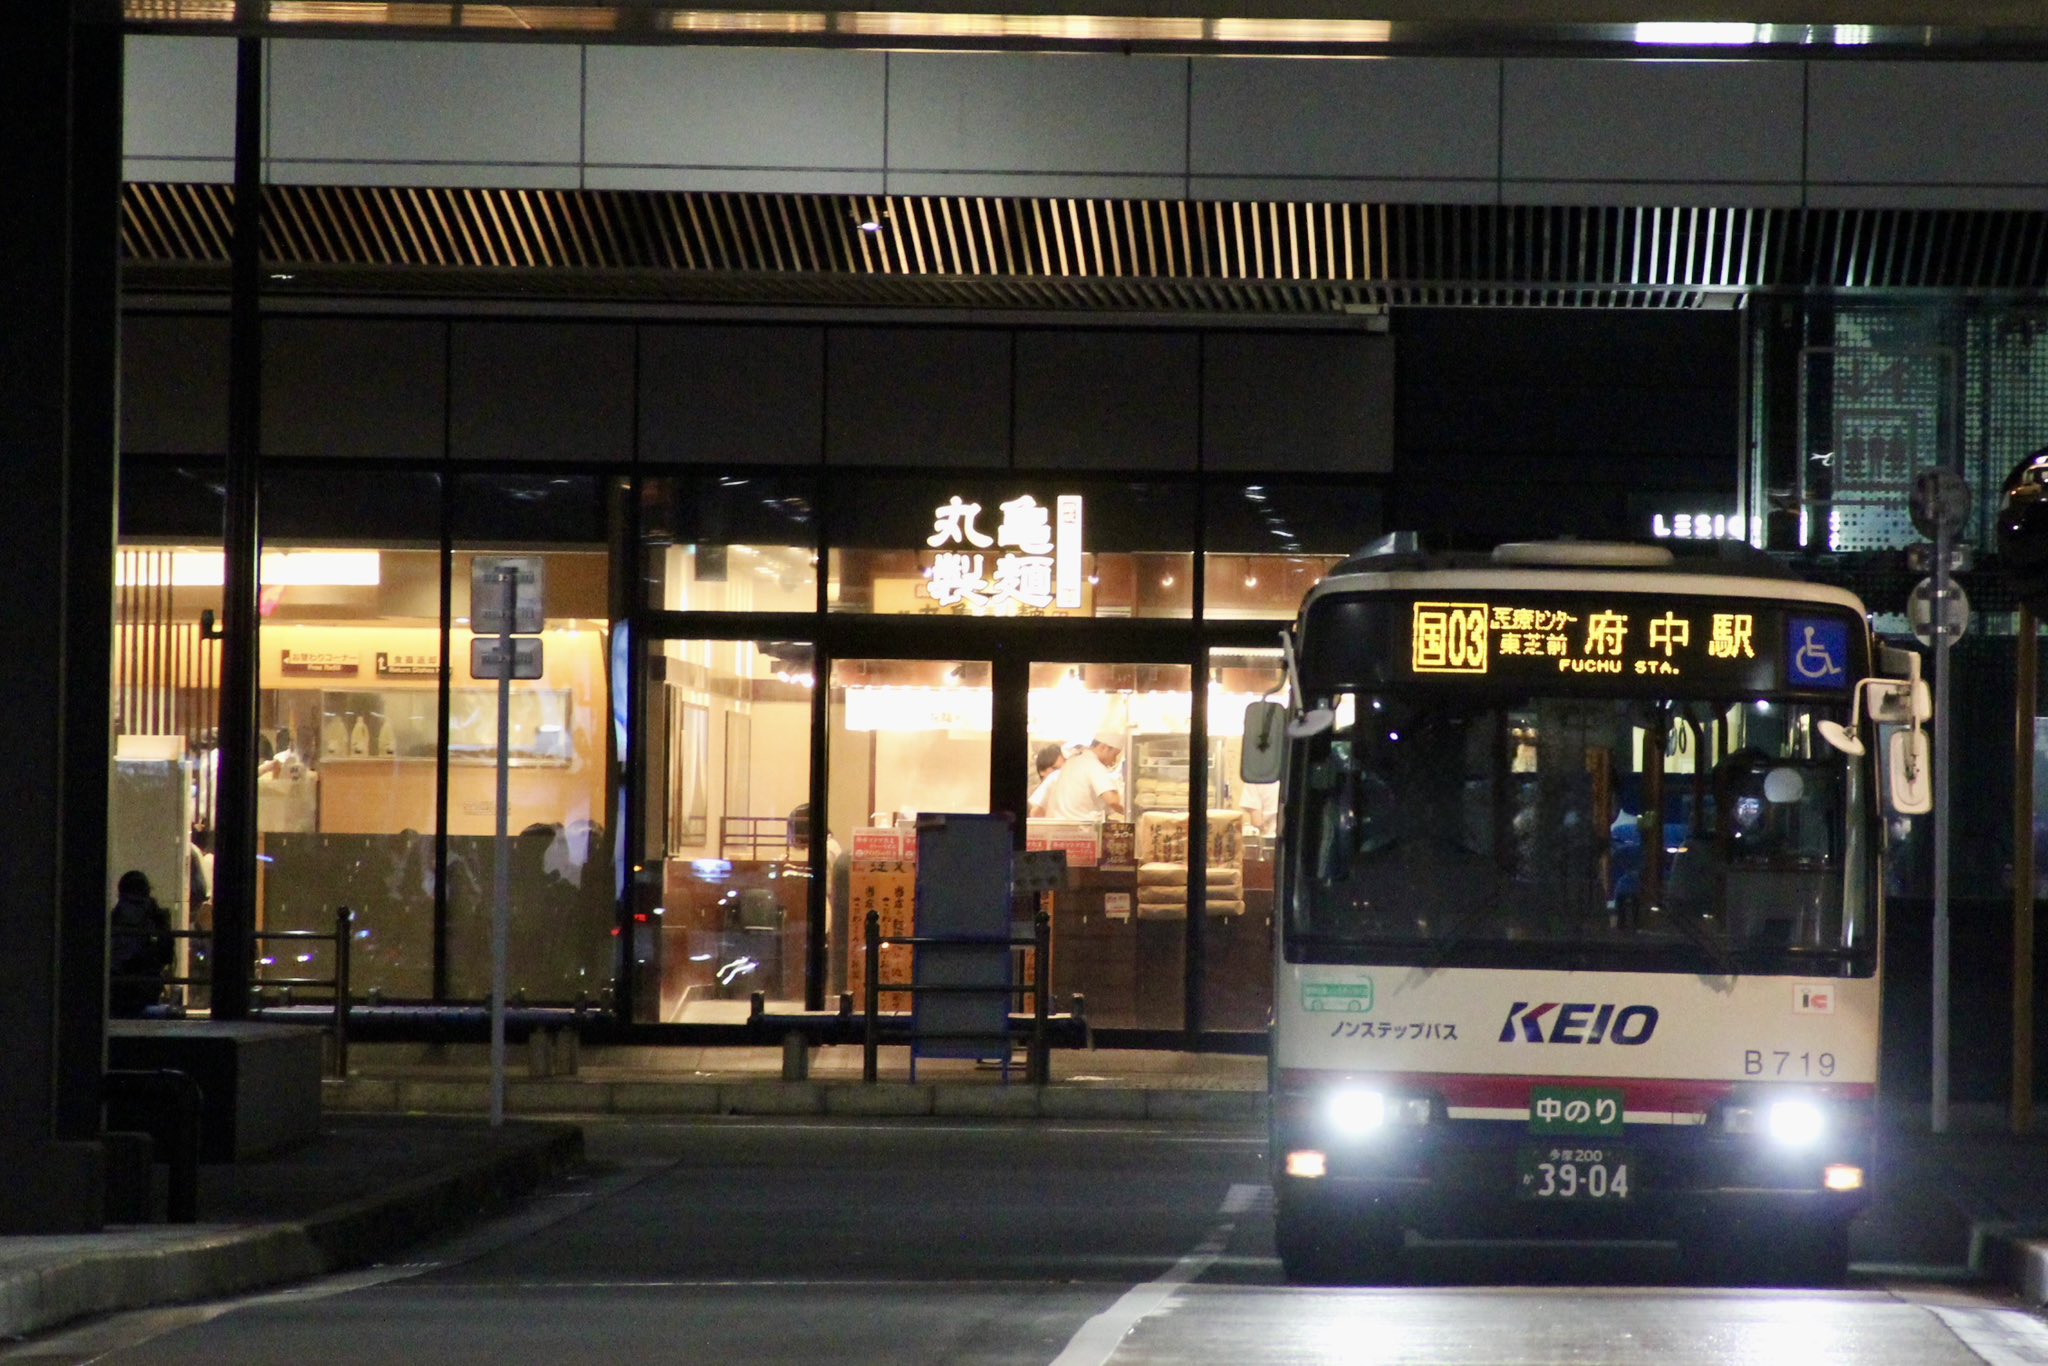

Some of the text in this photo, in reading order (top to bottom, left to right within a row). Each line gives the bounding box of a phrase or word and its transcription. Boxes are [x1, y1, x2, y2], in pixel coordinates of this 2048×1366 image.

[927, 495, 1055, 555] 丸亀
[927, 552, 1055, 608] 製麺
[1418, 609, 1484, 667] 国03
[1499, 632, 1568, 656] 東芝前
[1558, 658, 1680, 674] FUCHU STA.
[1330, 1020, 1459, 1042] ノンステップバス
[1498, 1001, 1659, 1046] KEIO
[1536, 1096, 1618, 1124] 中のり
[1537, 1162, 1628, 1198] 39-04
